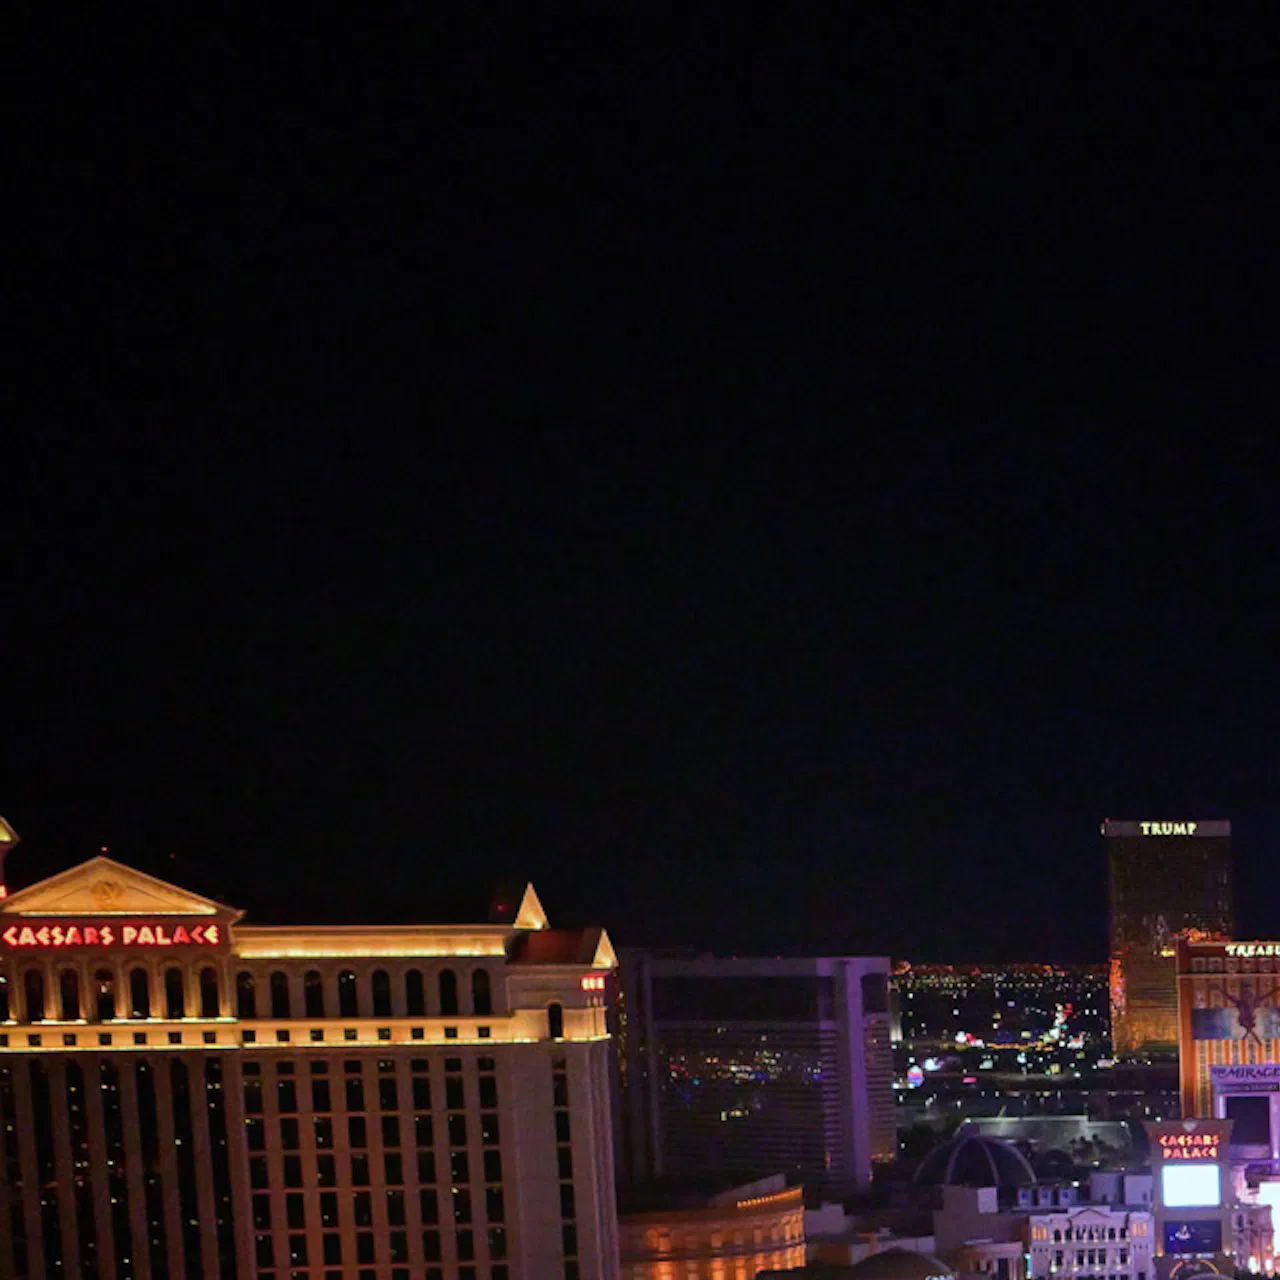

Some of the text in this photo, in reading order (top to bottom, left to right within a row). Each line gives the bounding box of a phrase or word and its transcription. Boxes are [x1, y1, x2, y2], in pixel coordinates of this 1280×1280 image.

[1140, 822, 1197, 835] TRUMP
[2, 925, 220, 946] CAESARS PALACE
[1159, 1134, 1220, 1147] CAESARS
[1163, 1147, 1218, 1159] PALACE
